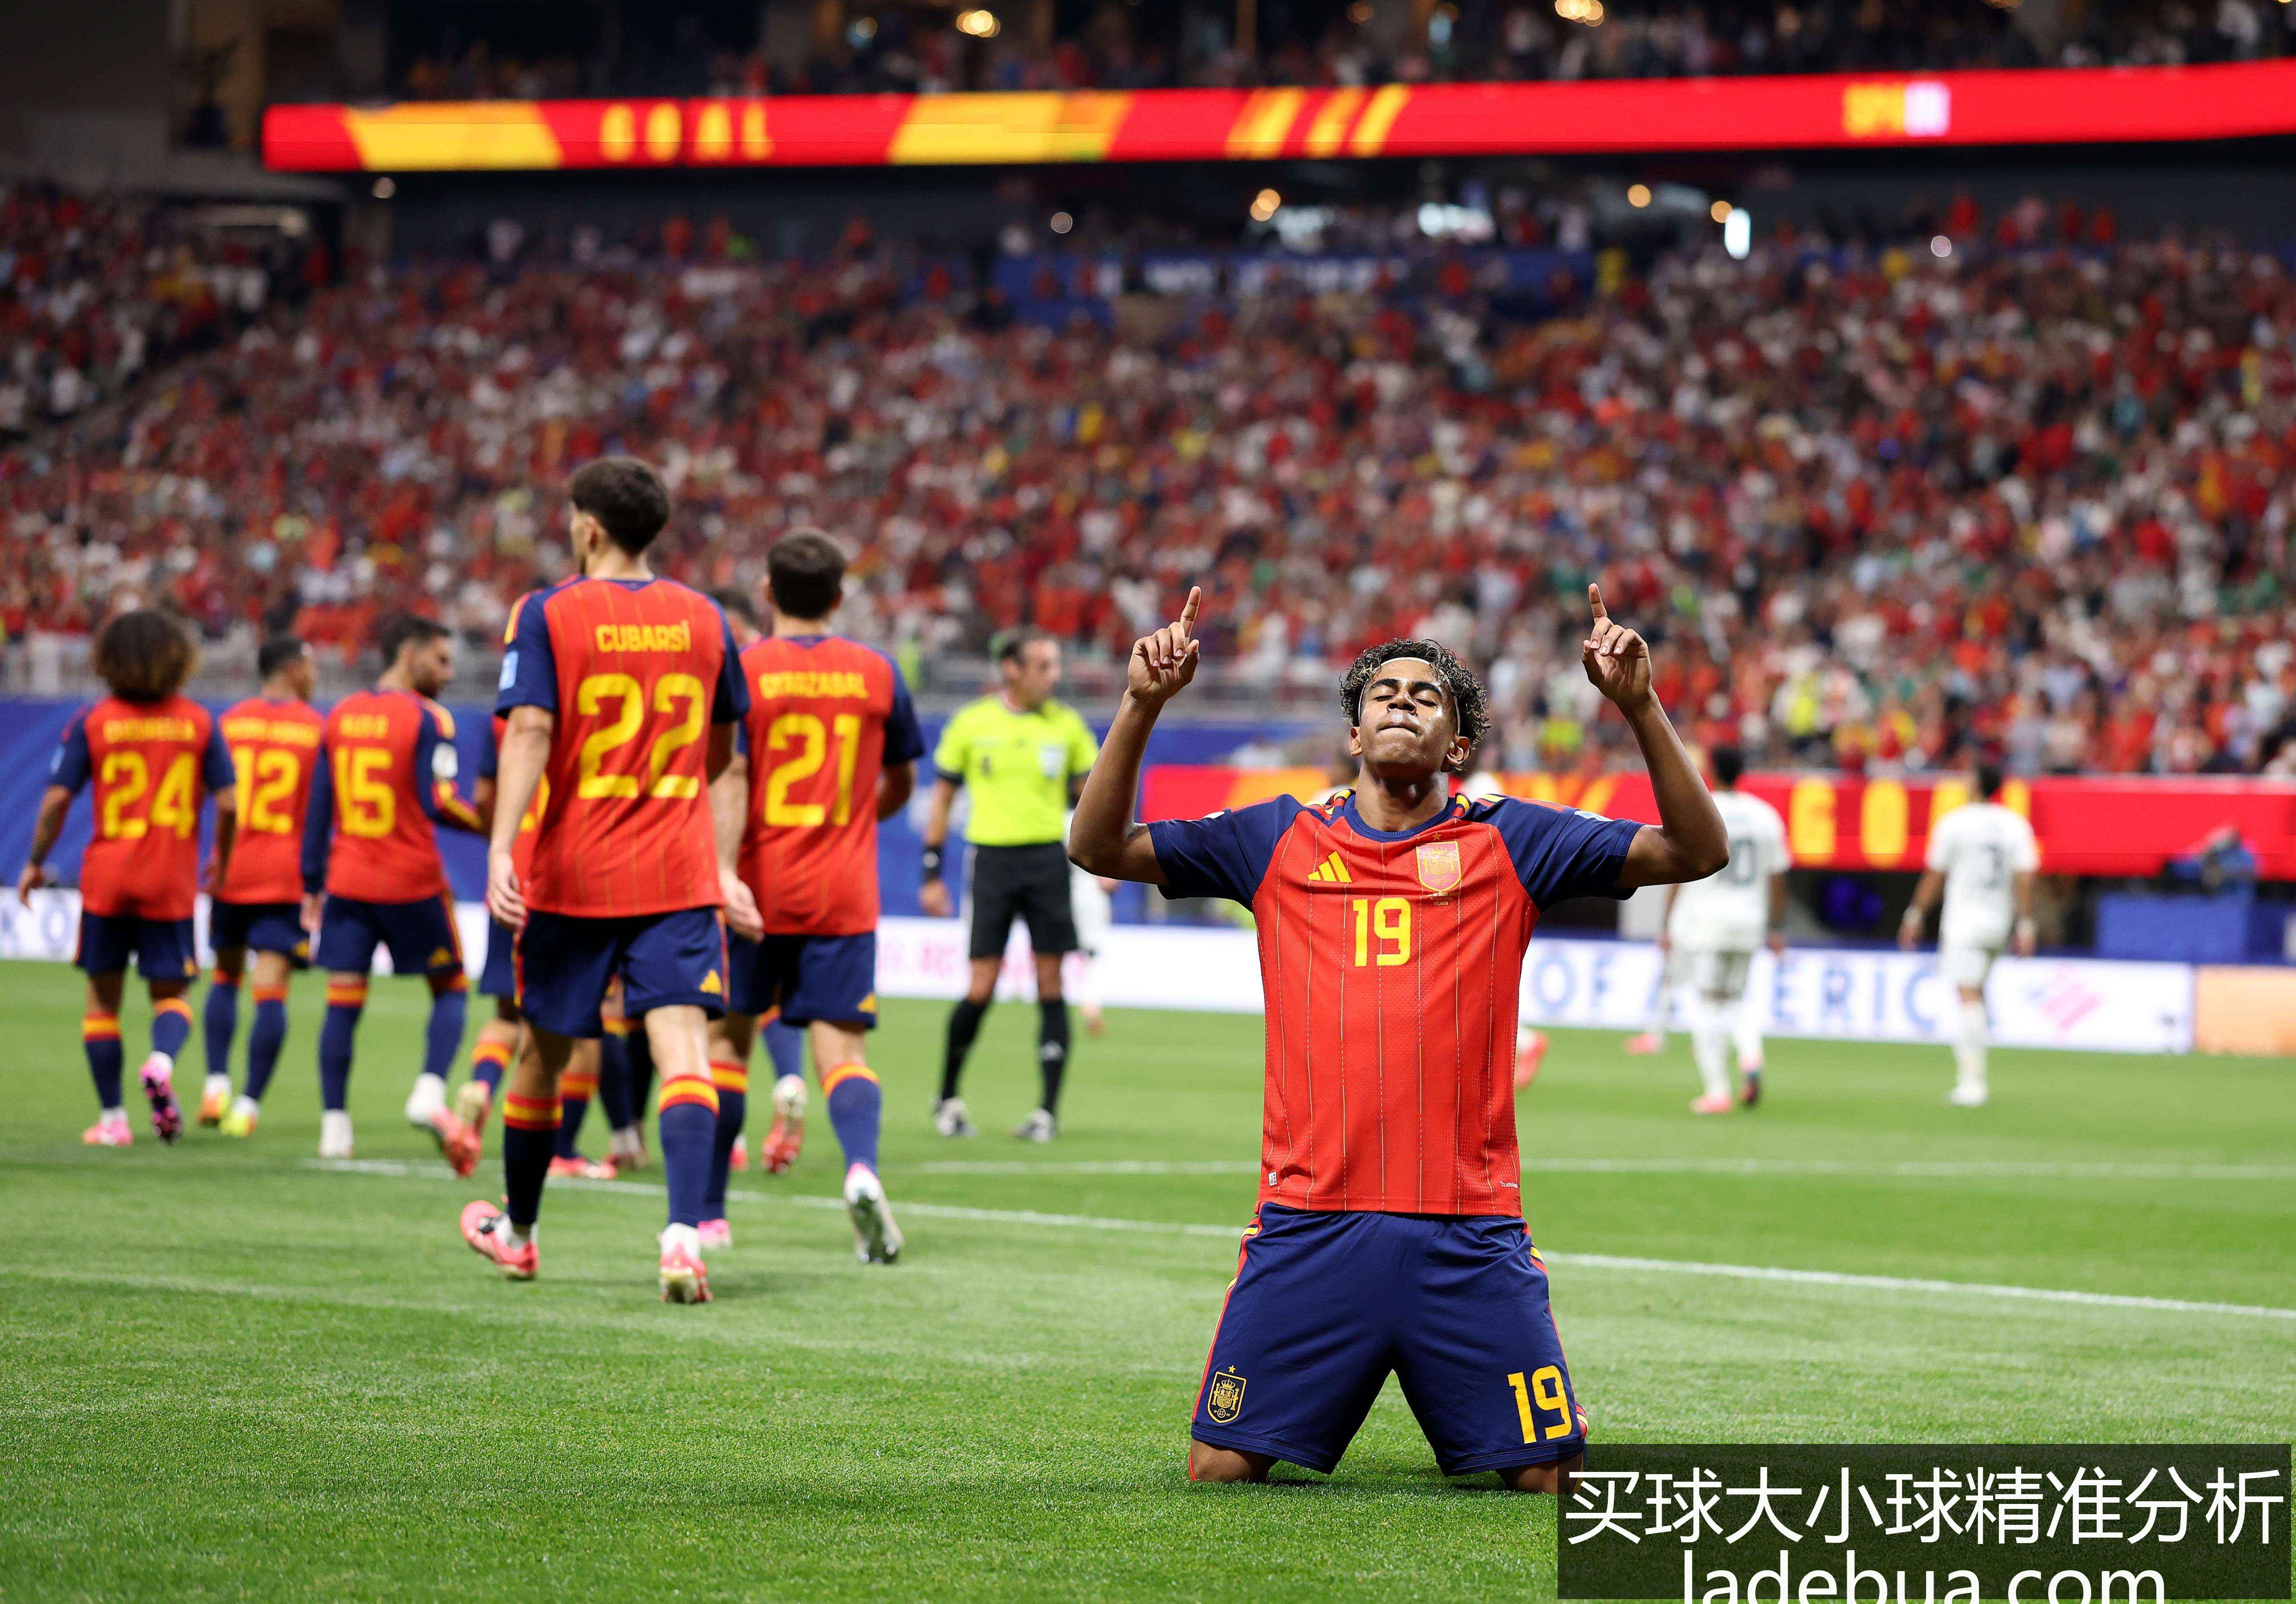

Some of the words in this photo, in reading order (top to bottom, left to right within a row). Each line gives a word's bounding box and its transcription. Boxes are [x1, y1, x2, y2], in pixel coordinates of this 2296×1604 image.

[578, 673, 705, 800] 22
[765, 714, 862, 828] 21
[102, 751, 195, 839] 24
[234, 746, 300, 836] 12
[334, 746, 396, 838] 15
[1352, 897, 1411, 967] 19
[1531, 954, 1613, 1016] OF
[1507, 1365, 1572, 1444] 19
